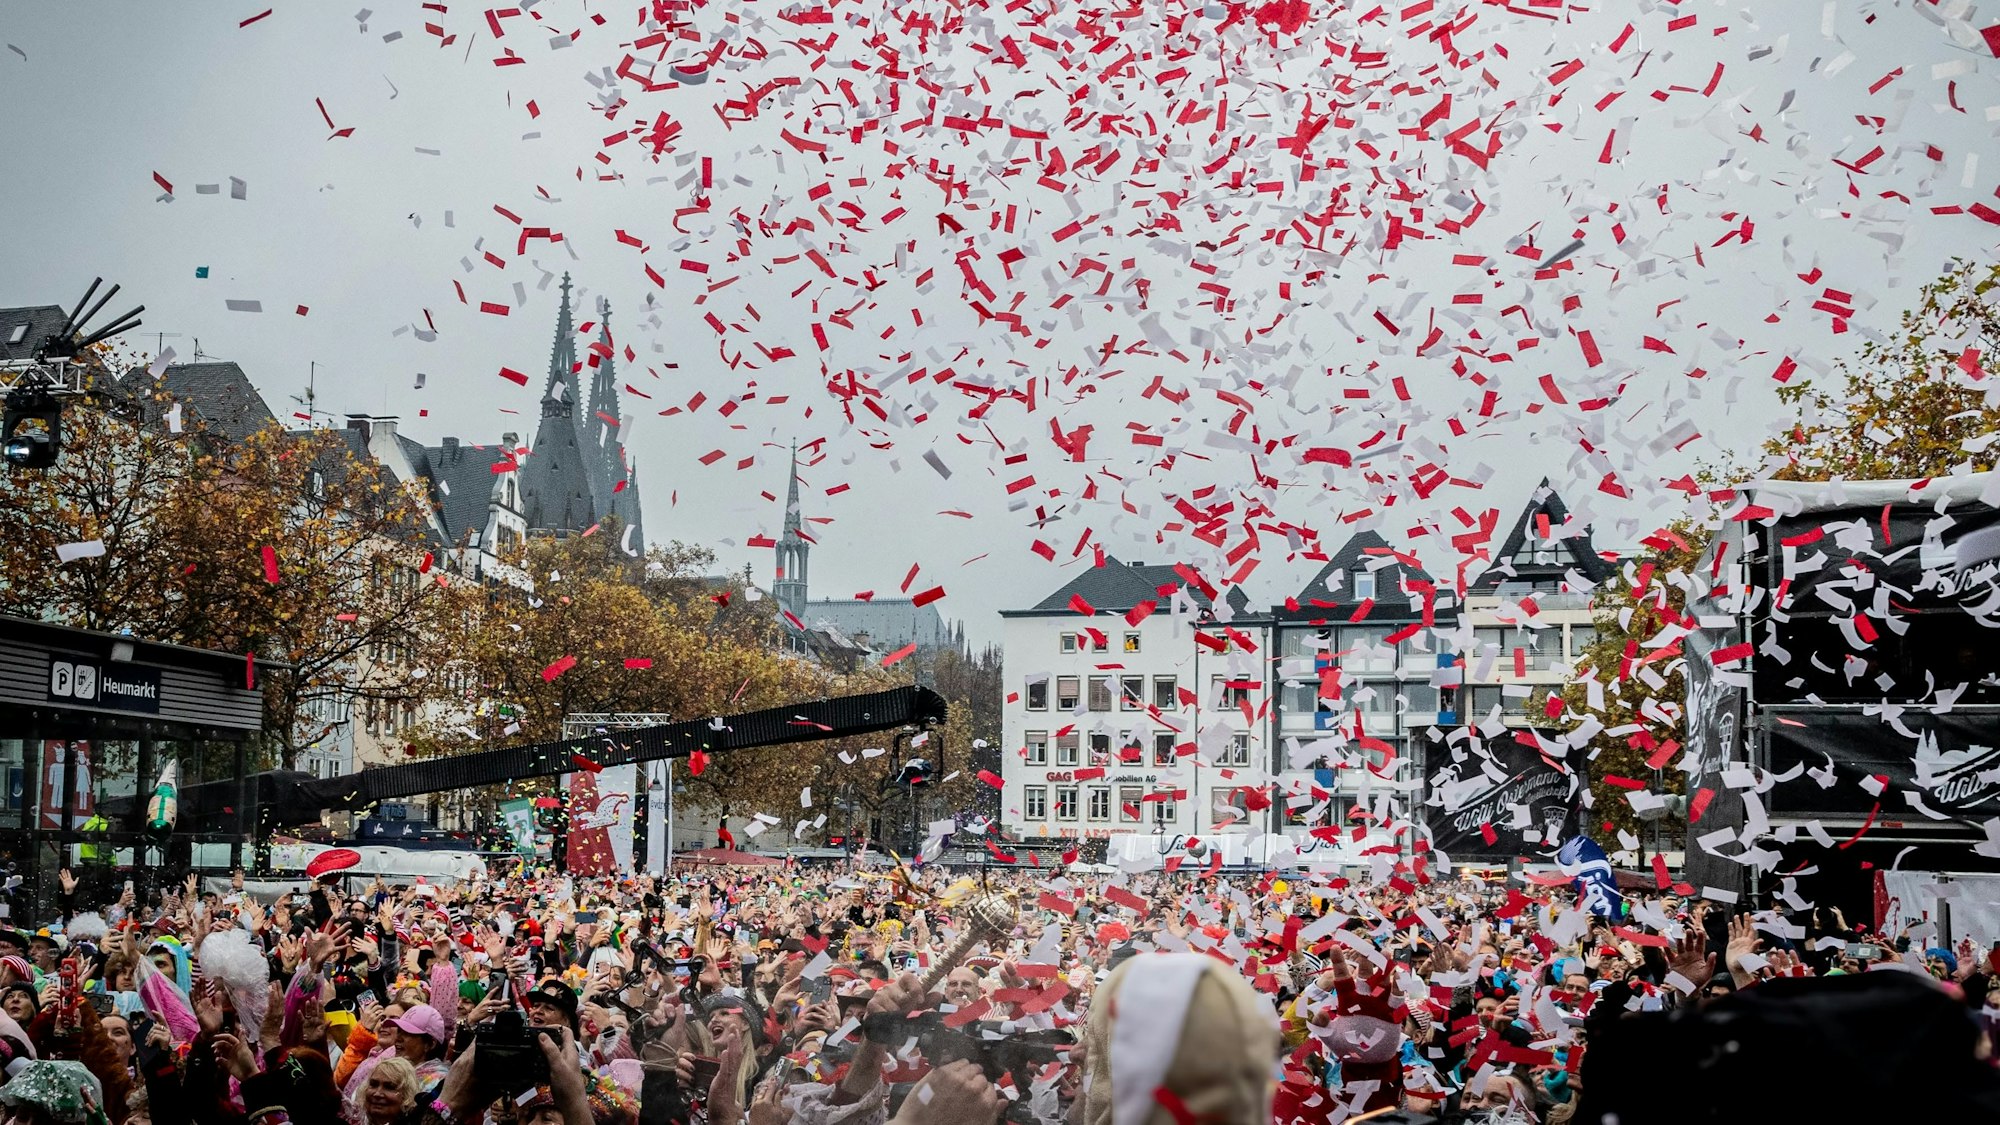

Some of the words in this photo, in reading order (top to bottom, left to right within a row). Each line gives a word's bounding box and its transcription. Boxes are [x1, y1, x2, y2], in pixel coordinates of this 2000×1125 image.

[103, 677, 156, 699] Heumarkt
[1046, 772, 1072, 782] GAG
[1145, 775, 1157, 783] AG
[1453, 802, 1495, 832] Willi
[1496, 771, 1561, 815] Ostermann
[1157, 834, 1188, 855] Sio
